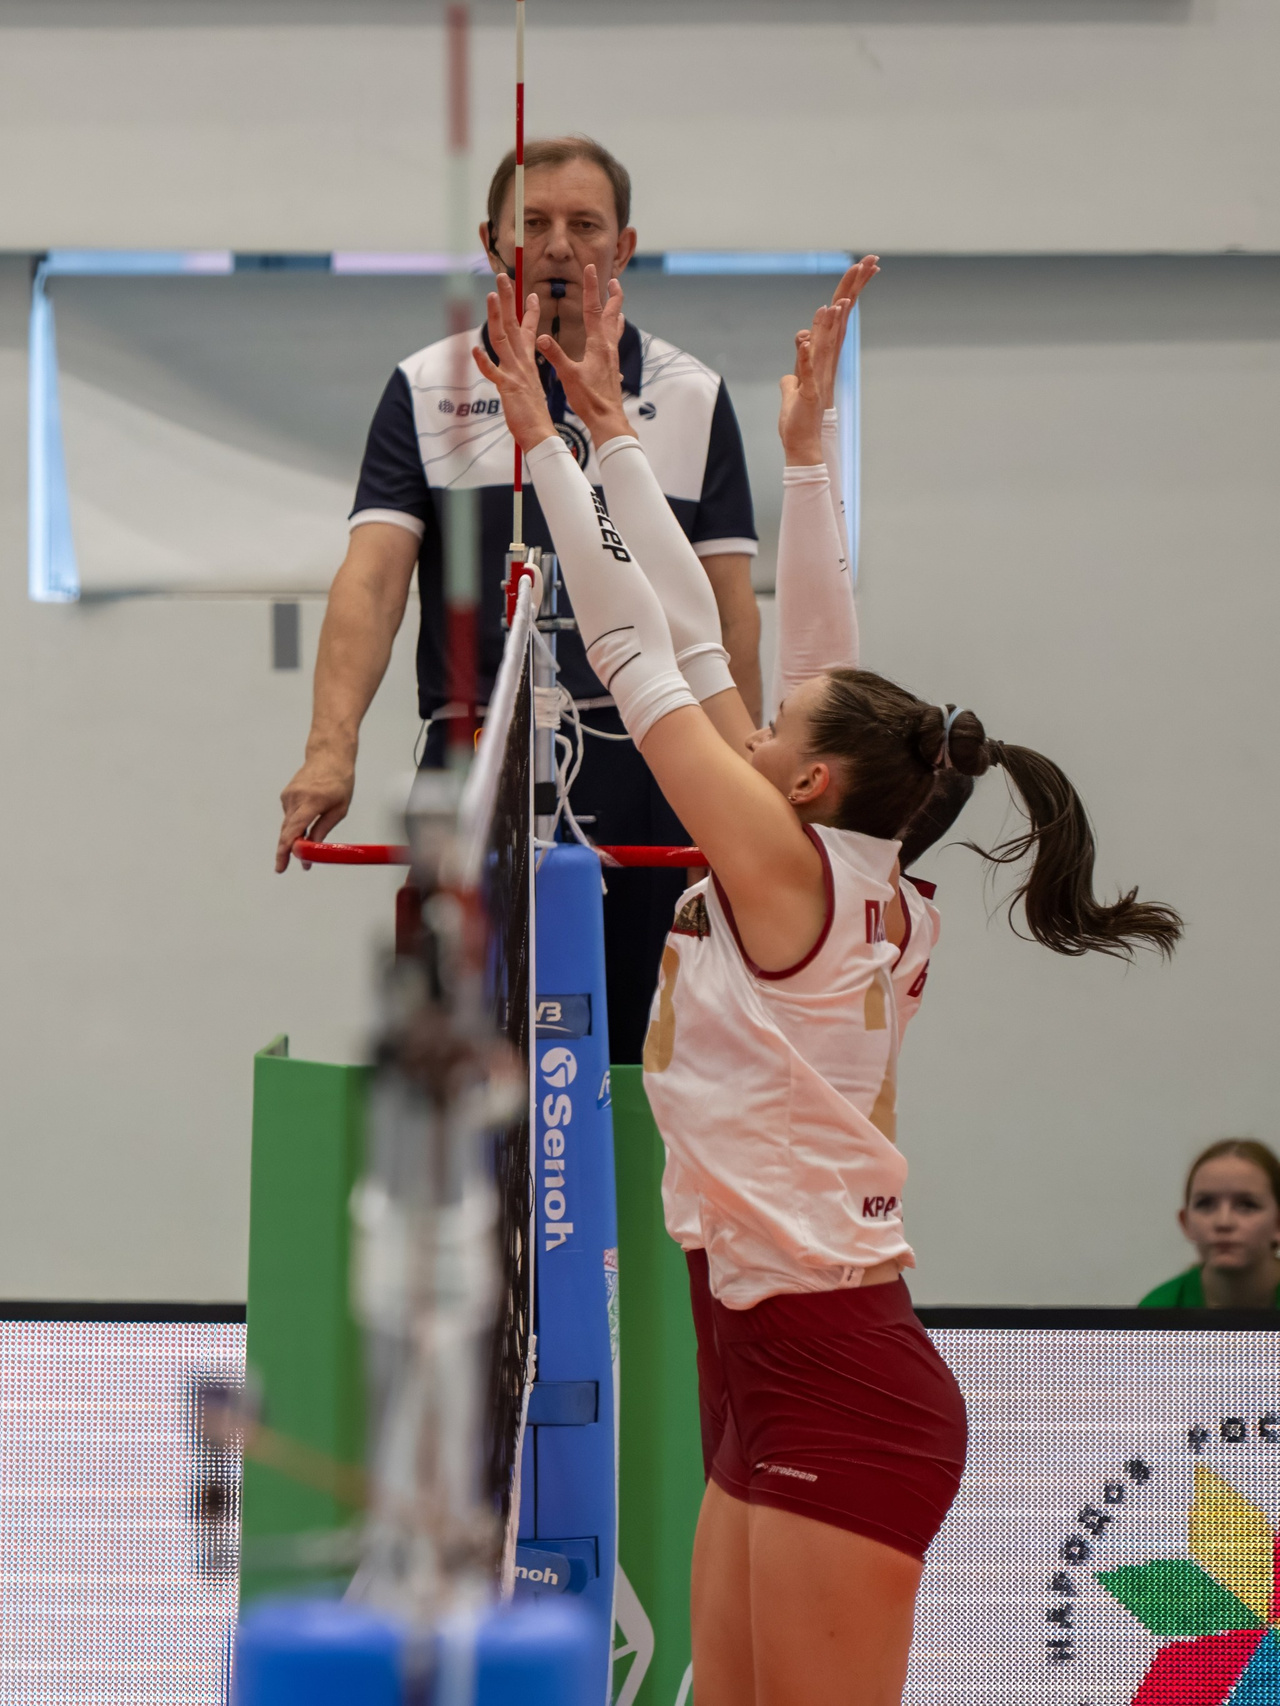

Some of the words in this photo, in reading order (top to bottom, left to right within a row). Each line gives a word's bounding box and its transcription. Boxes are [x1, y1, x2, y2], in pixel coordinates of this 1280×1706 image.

[455, 398, 500, 417] ВФВ
[542, 1093, 574, 1252] Senoh
[1045, 1455, 1152, 1664] НАРОДОВ
